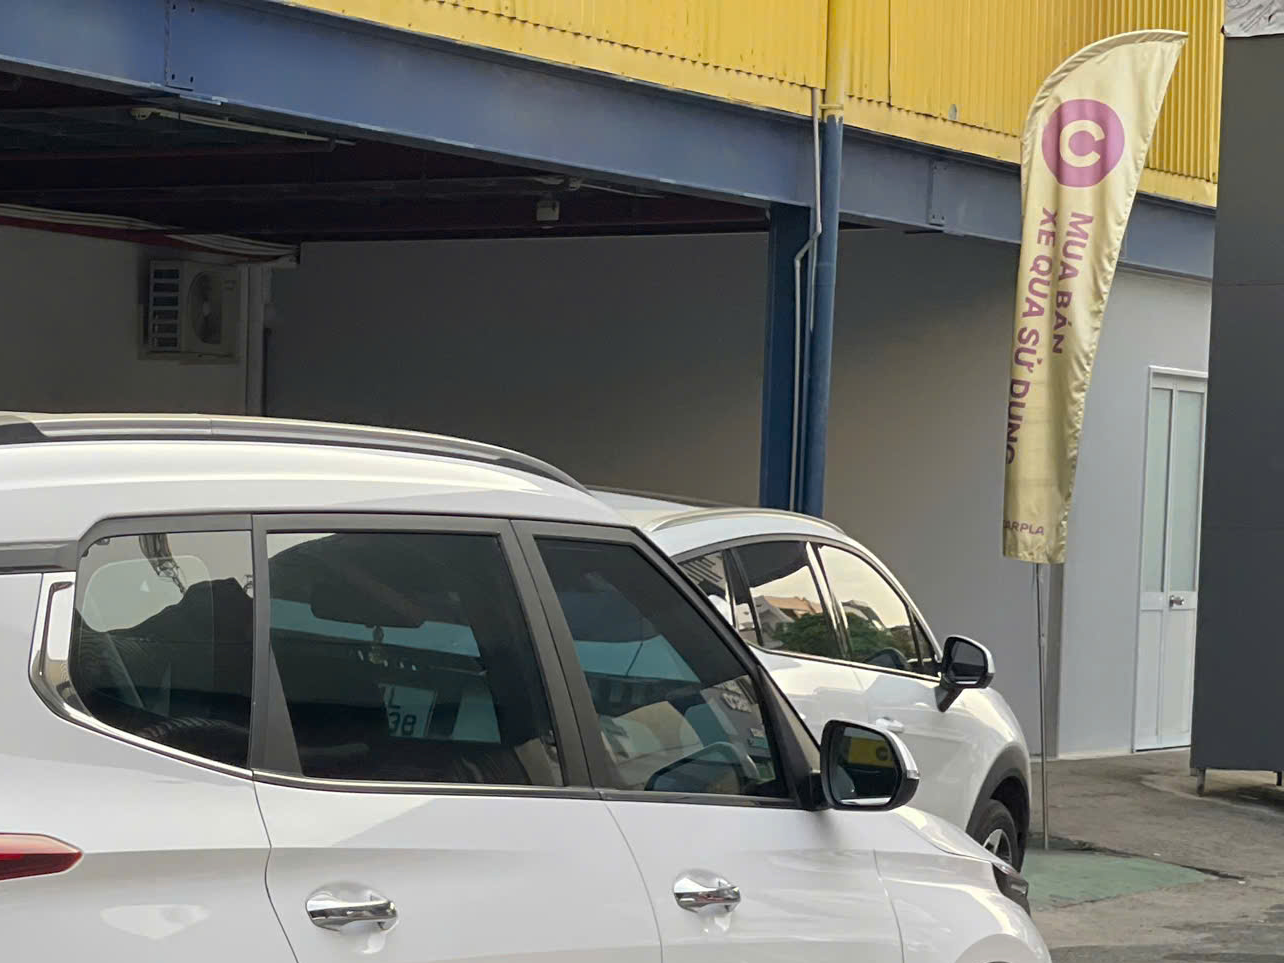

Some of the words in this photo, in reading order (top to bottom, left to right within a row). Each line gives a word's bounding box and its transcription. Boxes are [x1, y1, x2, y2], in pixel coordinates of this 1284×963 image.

[1037, 208, 1058, 248] XE
[1059, 212, 1094, 281] MUA
[1021, 255, 1053, 318] QUA
[1052, 291, 1073, 354] BÁN
